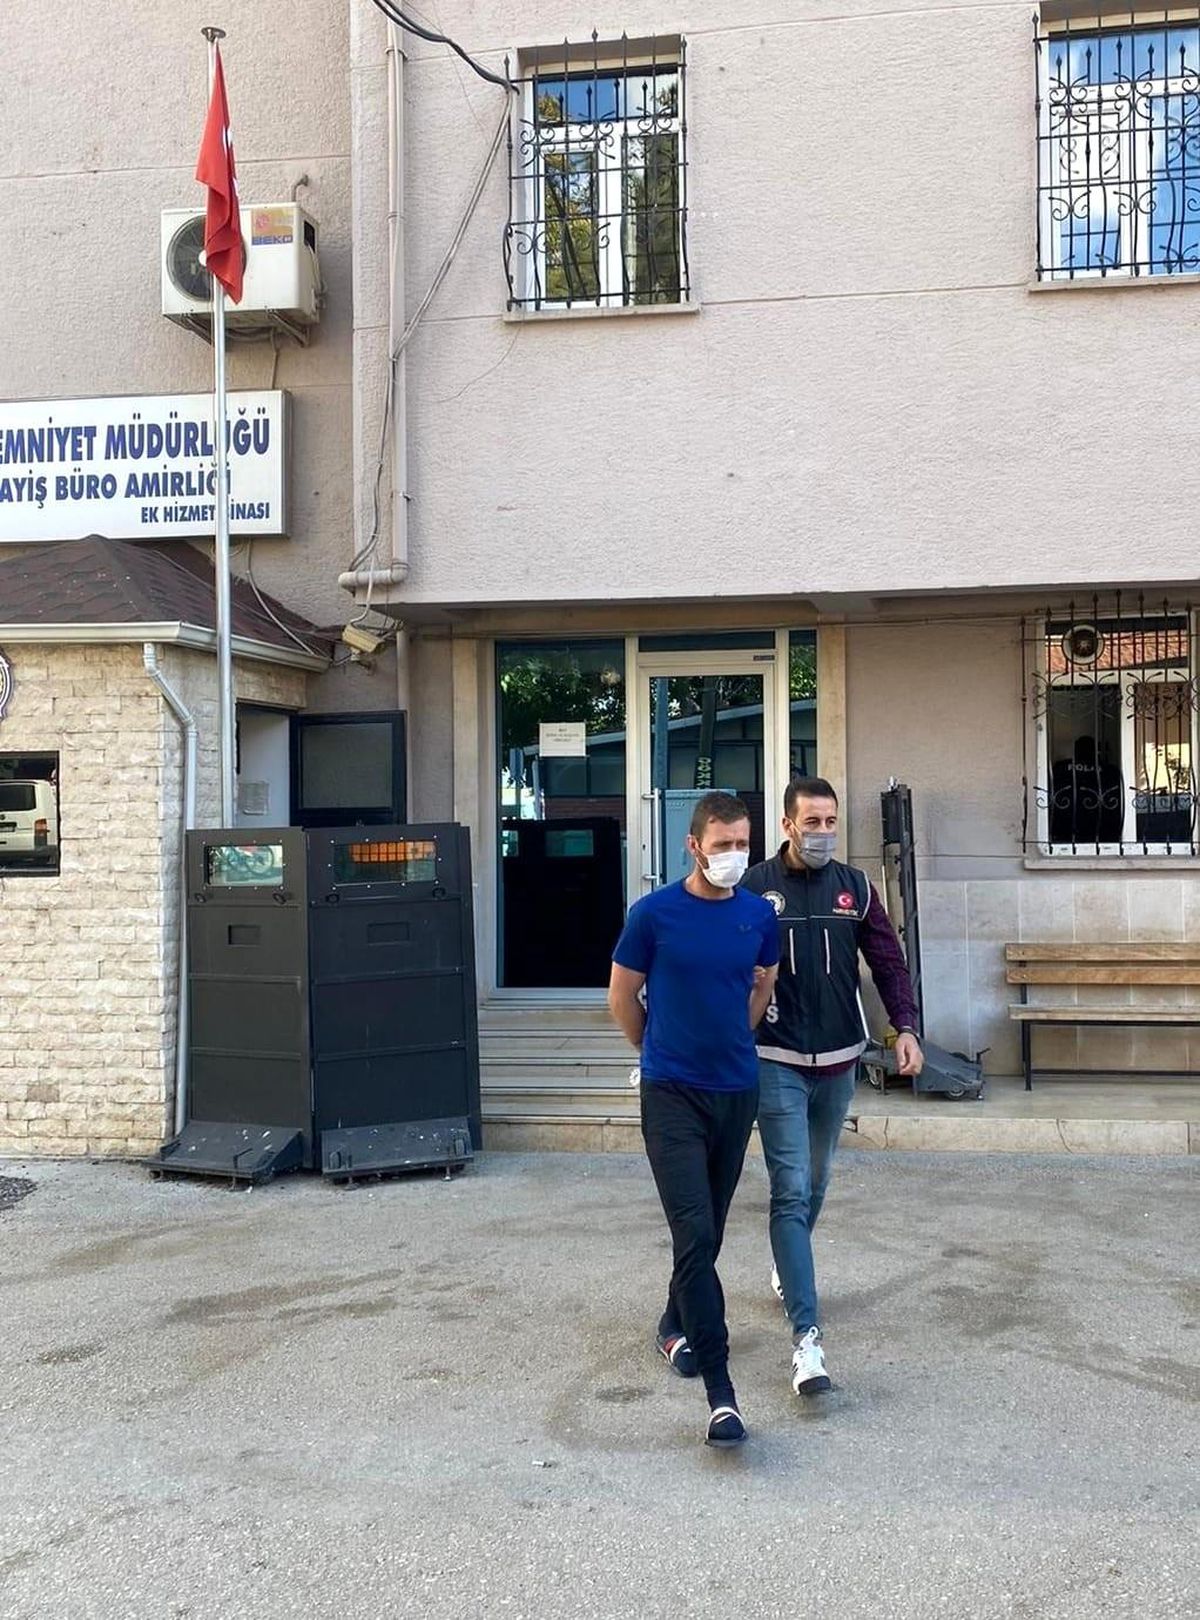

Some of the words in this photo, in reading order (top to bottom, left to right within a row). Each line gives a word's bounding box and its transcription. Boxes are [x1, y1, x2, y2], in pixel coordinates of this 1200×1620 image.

[0, 416, 97, 464] MNİYET
[55, 468, 117, 501] BÜRO
[141, 507, 159, 523] EK
[163, 501, 216, 523] HİZMET
[227, 498, 270, 520] İNASI
